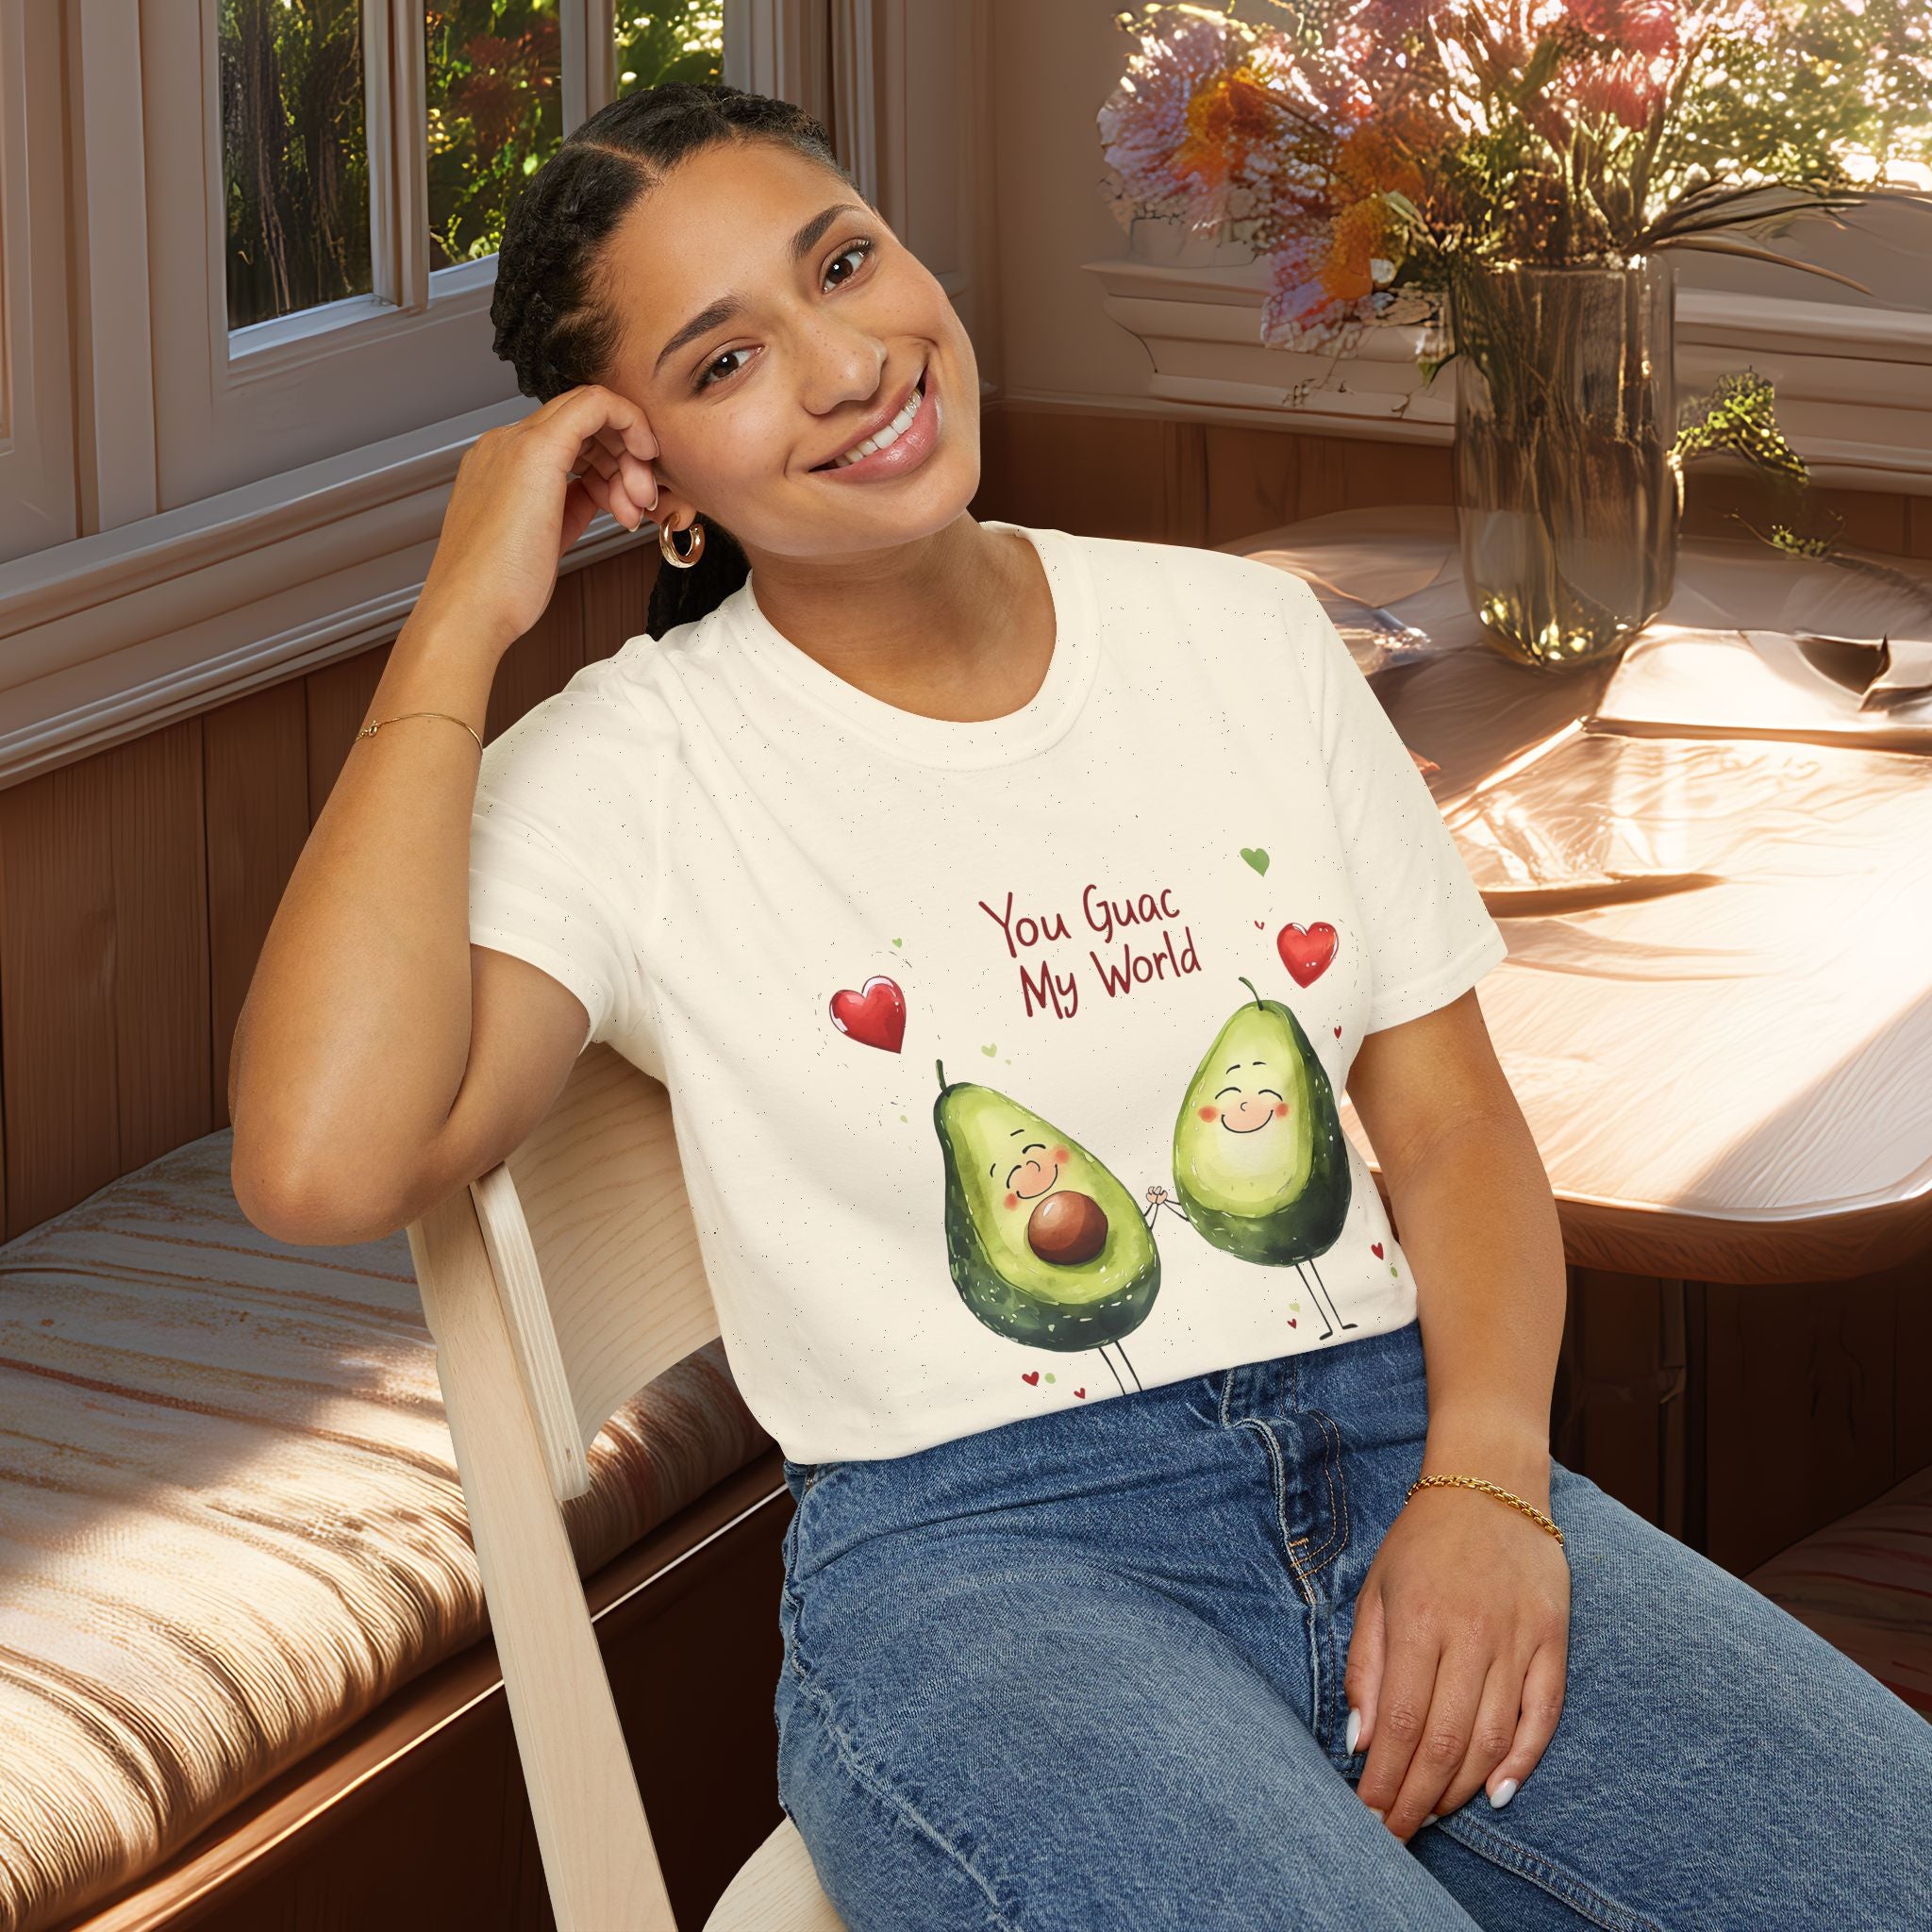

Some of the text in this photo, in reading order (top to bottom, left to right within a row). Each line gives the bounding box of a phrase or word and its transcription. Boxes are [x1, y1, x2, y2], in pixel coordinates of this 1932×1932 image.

[978, 884, 1180, 958] You Guac
[1020, 926, 1202, 1020] My World
